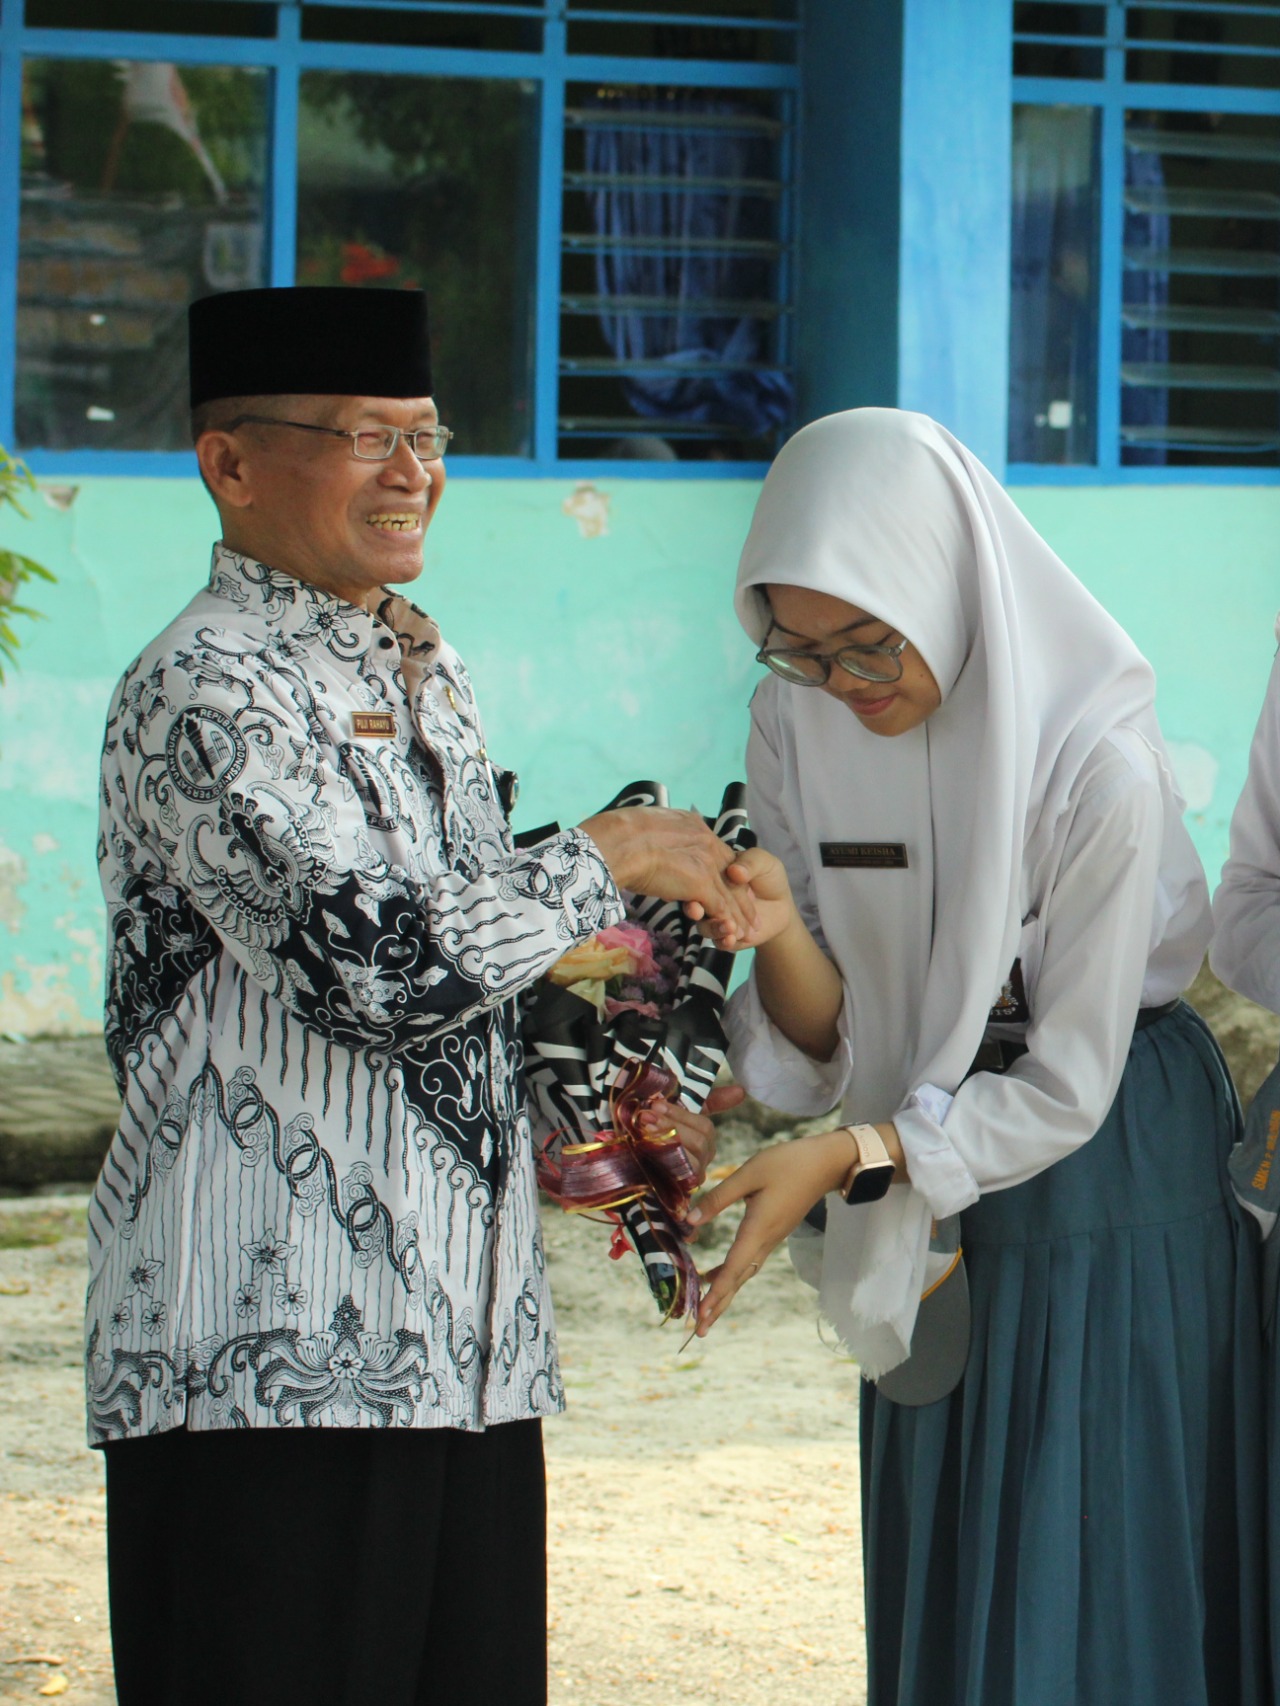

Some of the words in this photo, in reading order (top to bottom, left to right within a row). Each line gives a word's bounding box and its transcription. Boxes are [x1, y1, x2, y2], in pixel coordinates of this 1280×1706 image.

[369, 719, 390, 731] RAHAYU
[167, 726, 181, 756] GURU
[200, 708, 240, 740] REPUBLIK
[223, 738, 247, 781] INDONESIA
[860, 847, 896, 857] KEISHA
